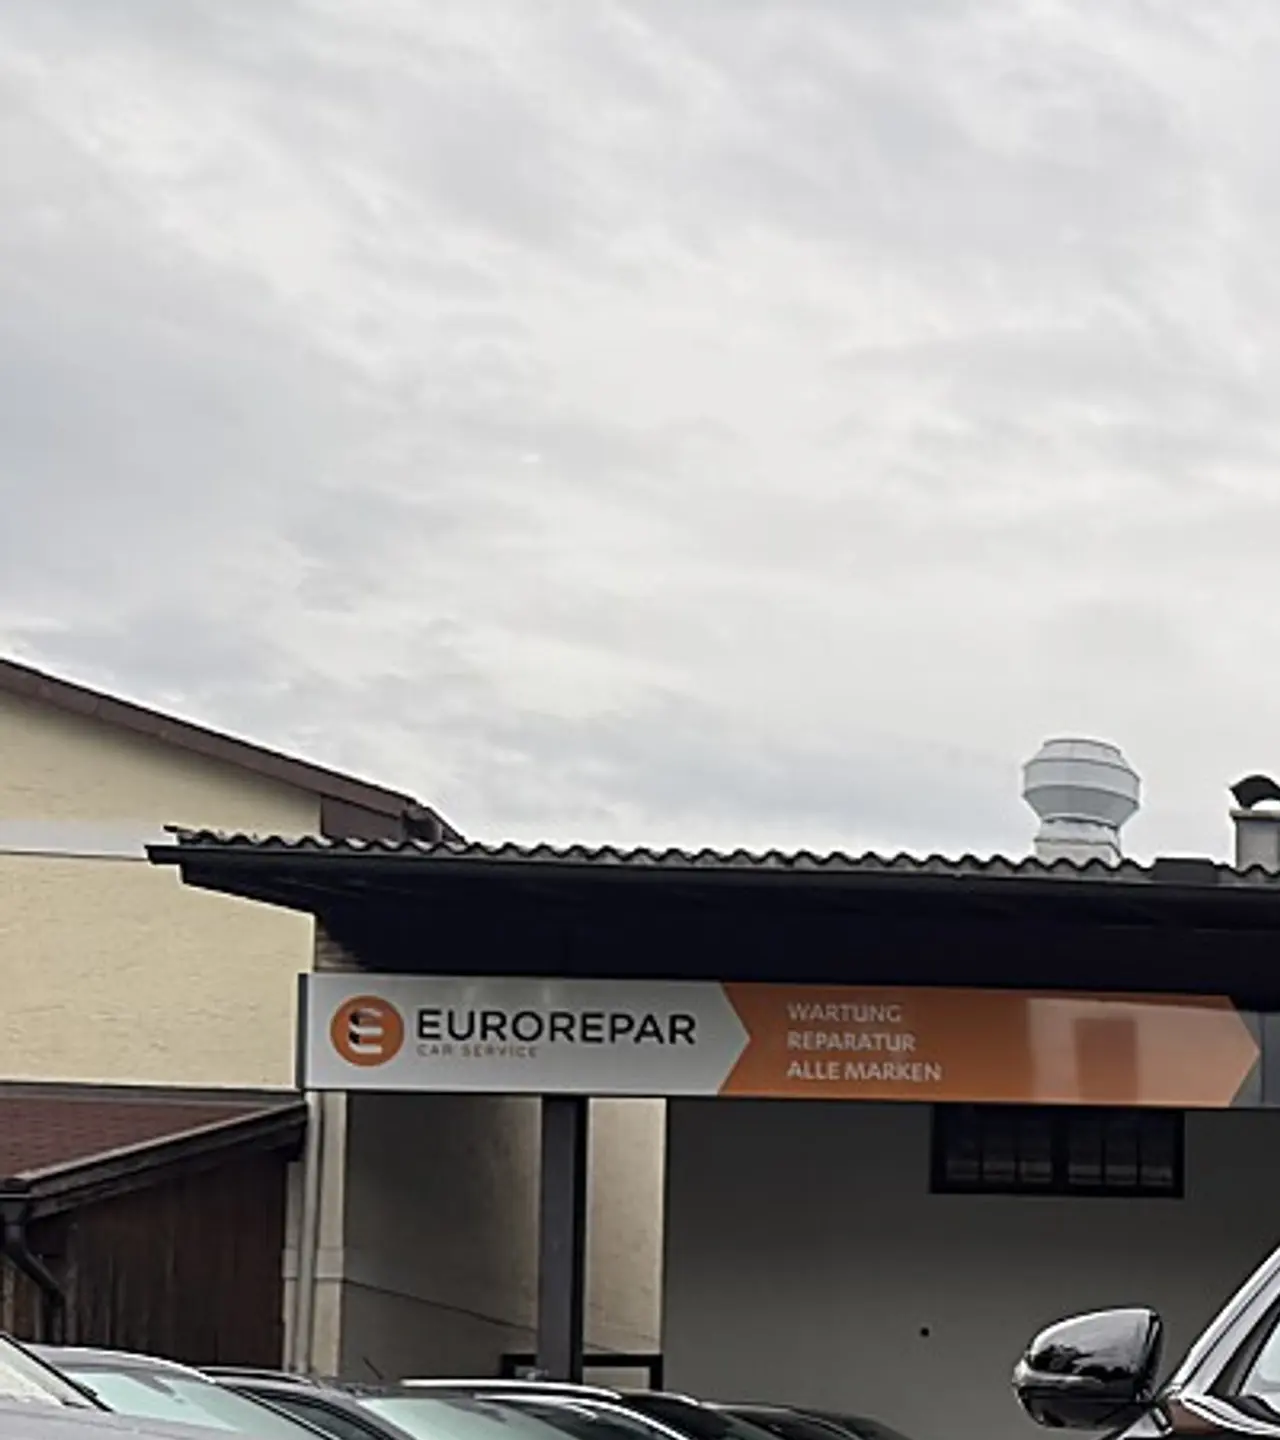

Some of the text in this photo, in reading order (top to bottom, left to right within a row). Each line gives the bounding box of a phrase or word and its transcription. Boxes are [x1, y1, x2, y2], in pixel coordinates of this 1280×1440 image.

[787, 1003, 901, 1023] WARTUNG
[416, 1008, 697, 1046] EUROREPAR
[417, 1045, 538, 1059] CAR SERVICE
[787, 1031, 917, 1052] REPARATUR
[786, 1060, 943, 1082] ALLE MARKEN
